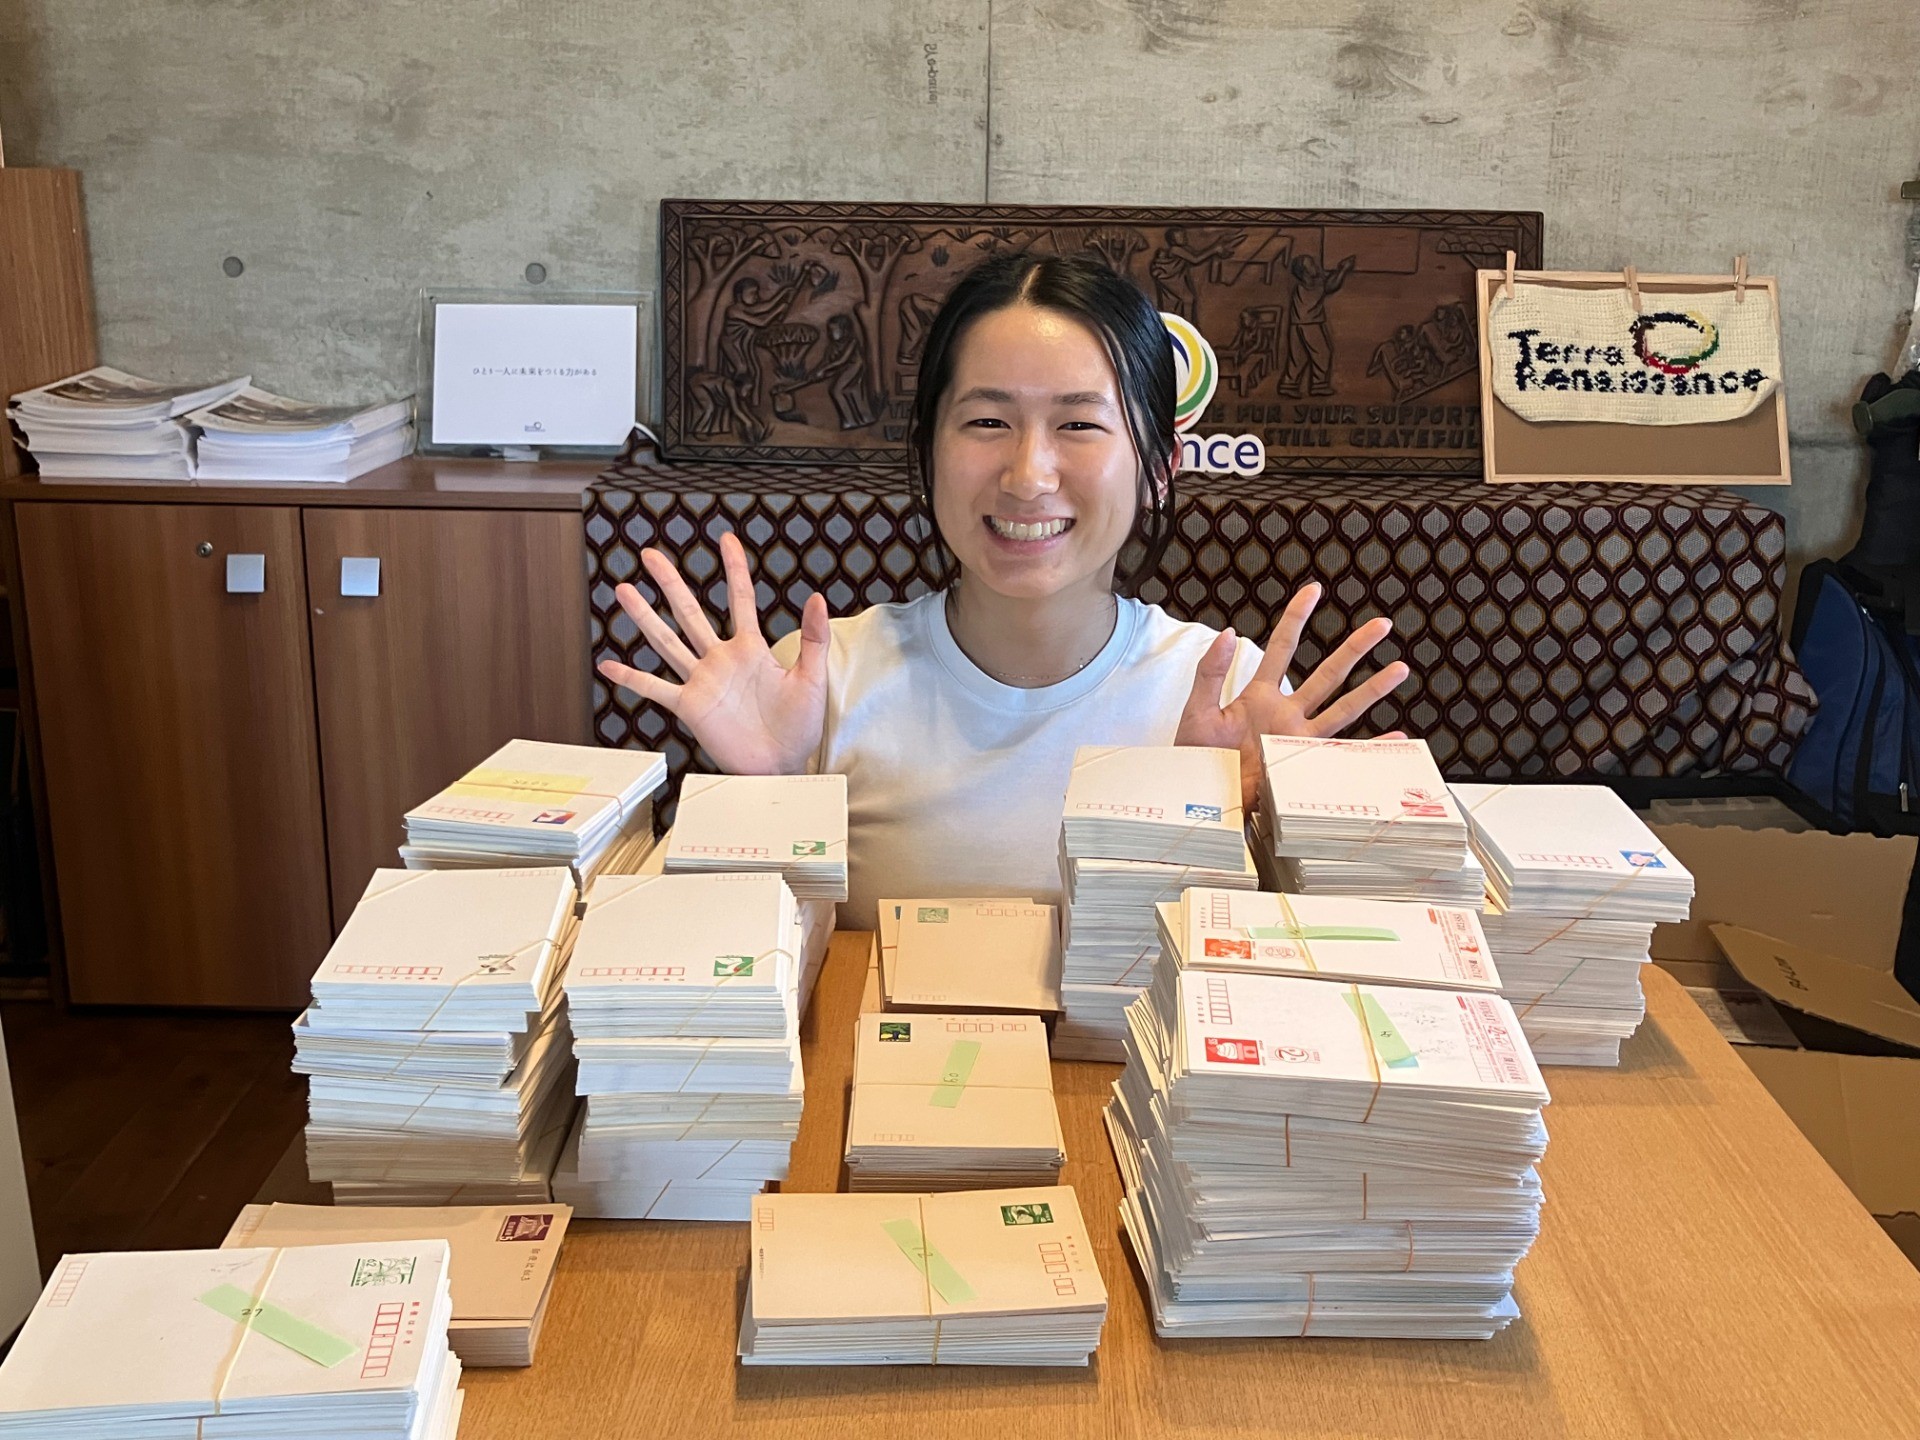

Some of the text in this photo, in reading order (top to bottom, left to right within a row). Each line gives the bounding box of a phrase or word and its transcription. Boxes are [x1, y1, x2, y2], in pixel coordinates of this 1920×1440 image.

[1507, 329, 1625, 365] Terra
[1237, 404, 1281, 424] FOR
[1294, 404, 1357, 425] YOUR
[1367, 404, 1480, 425] SUPPORT
[1263, 428, 1332, 447] STILL
[1350, 428, 1480, 449] GRATEFUL
